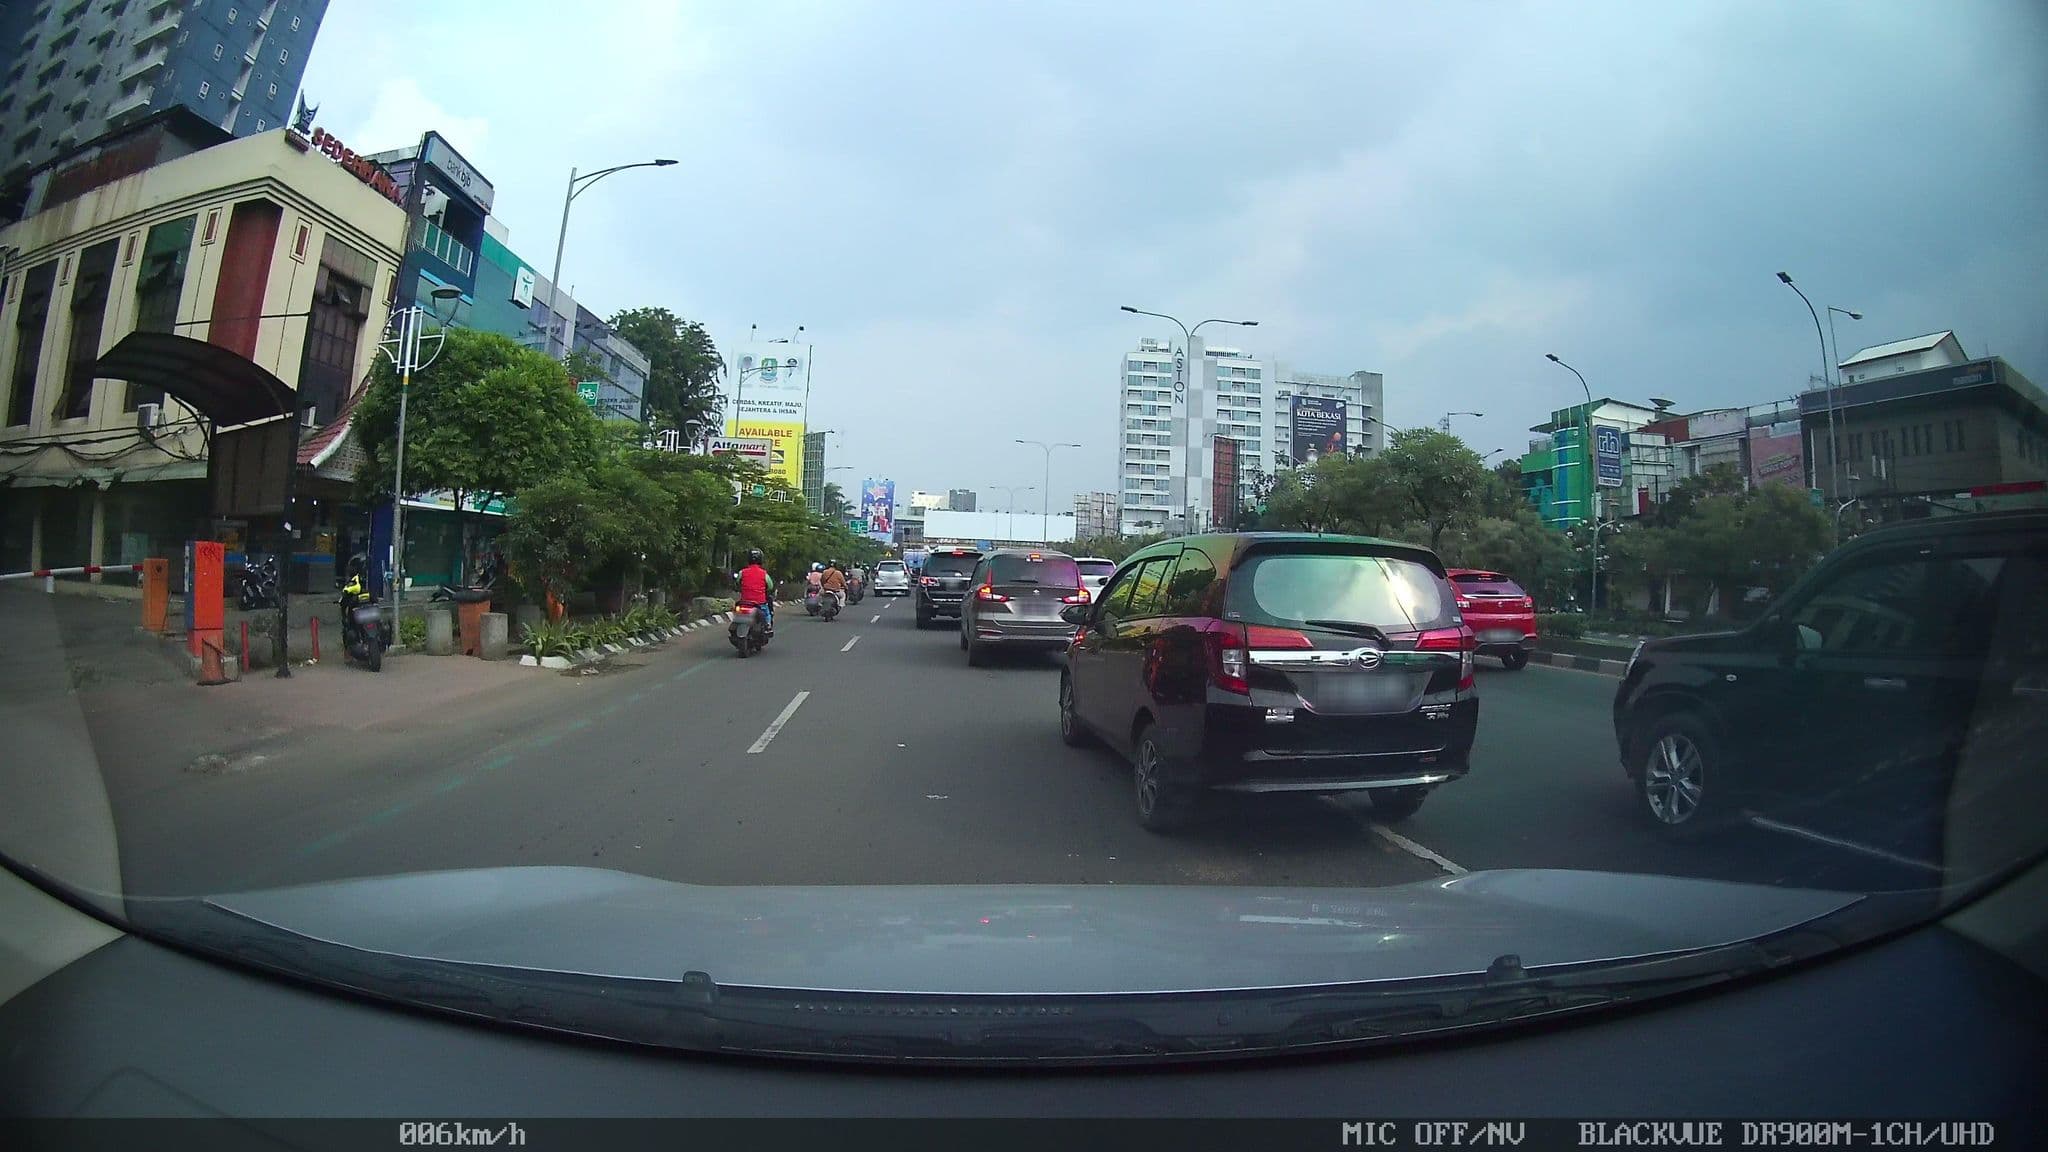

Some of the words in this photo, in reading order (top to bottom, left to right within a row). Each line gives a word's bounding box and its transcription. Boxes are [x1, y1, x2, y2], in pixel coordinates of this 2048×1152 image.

[460, 168, 472, 188] bjb
[1173, 346, 1185, 404] ASTON
[1296, 409, 1316, 418] KOTA
[1316, 411, 1342, 421] BEKASI
[739, 428, 793, 438] AVAILABLE
[712, 441, 767, 451] Alfamart
